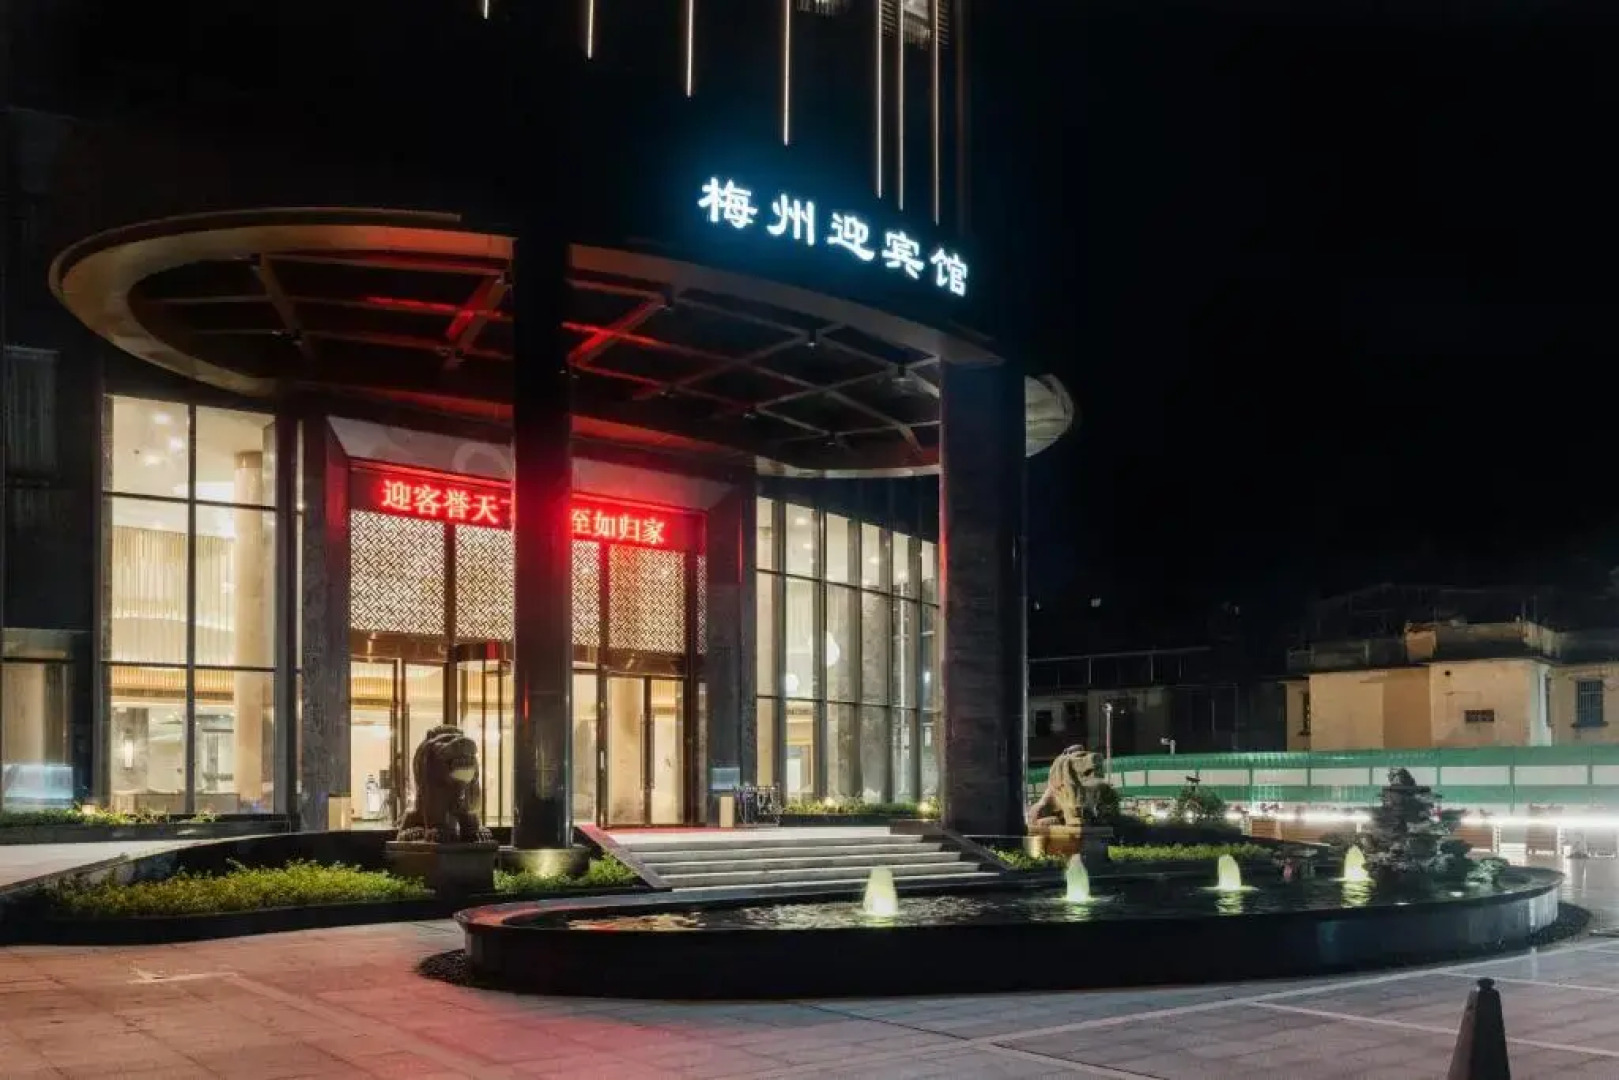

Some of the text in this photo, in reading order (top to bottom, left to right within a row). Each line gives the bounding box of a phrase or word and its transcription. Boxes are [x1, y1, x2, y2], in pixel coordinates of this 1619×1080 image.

[697, 176, 968, 297] 梅州迎宾馆
[571, 508, 665, 544] 至如归家
